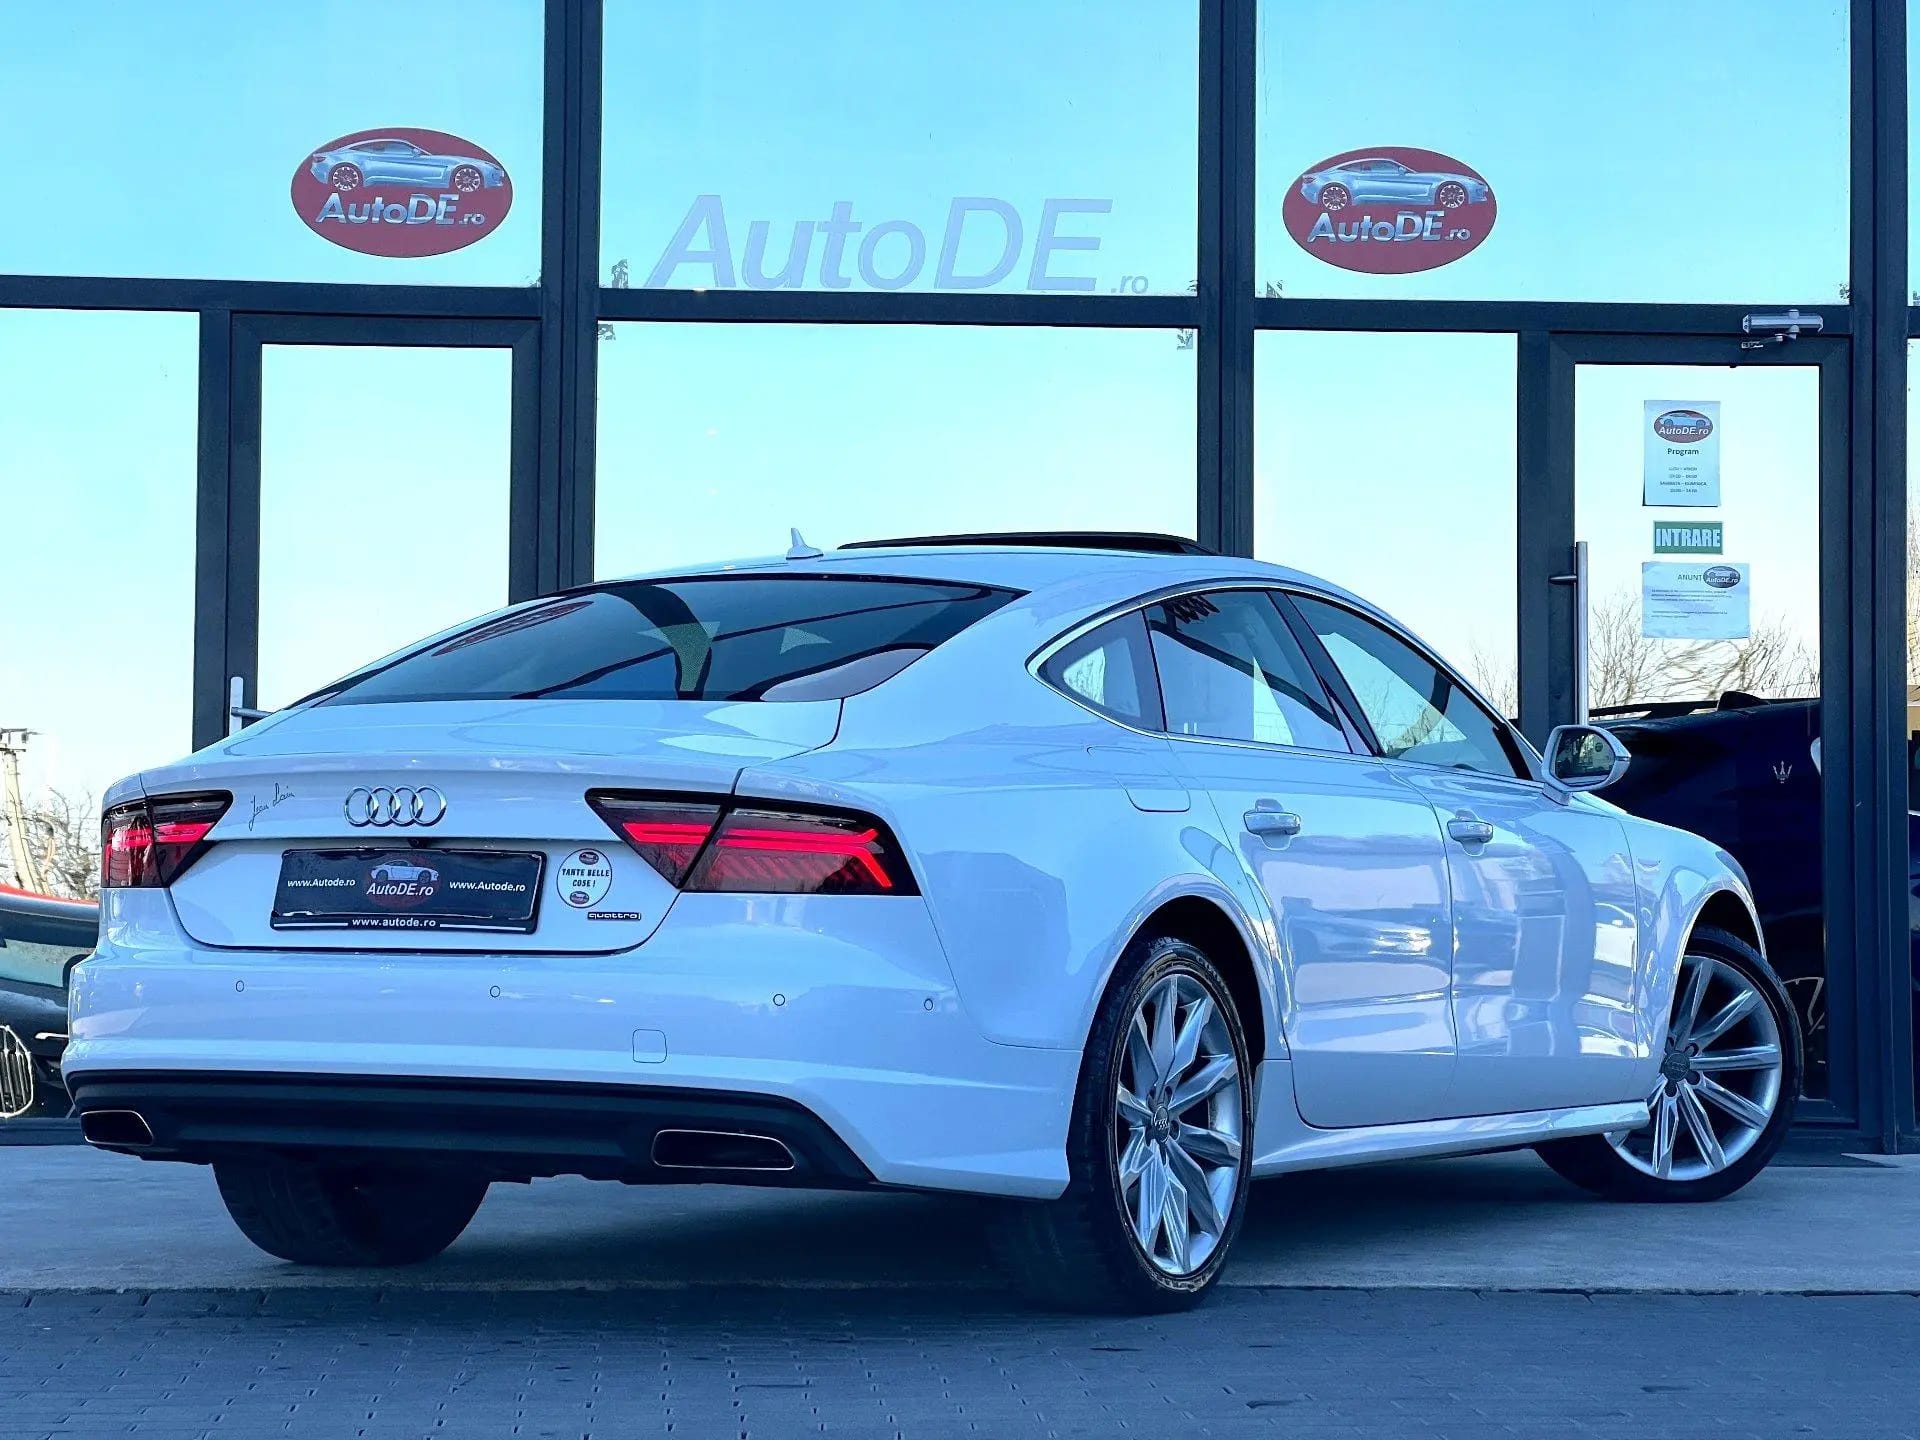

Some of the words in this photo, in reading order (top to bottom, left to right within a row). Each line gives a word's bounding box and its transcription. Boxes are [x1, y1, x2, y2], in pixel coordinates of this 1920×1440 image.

[1658, 426, 1709, 436] AutoDE.ro
[1667, 447, 1699, 456] Program
[1655, 528, 1721, 547] INTRARE
[562, 868, 585, 876] TANTE
[587, 869, 610, 877] BELLE
[287, 878, 356, 888] www.Autode.ro
[449, 880, 526, 893] www.Autode.ro
[572, 879, 591, 887] COSE
[366, 882, 434, 897] AutoDE.ro
[588, 912, 638, 920] quattro
[352, 917, 436, 928] www.autode.ro
